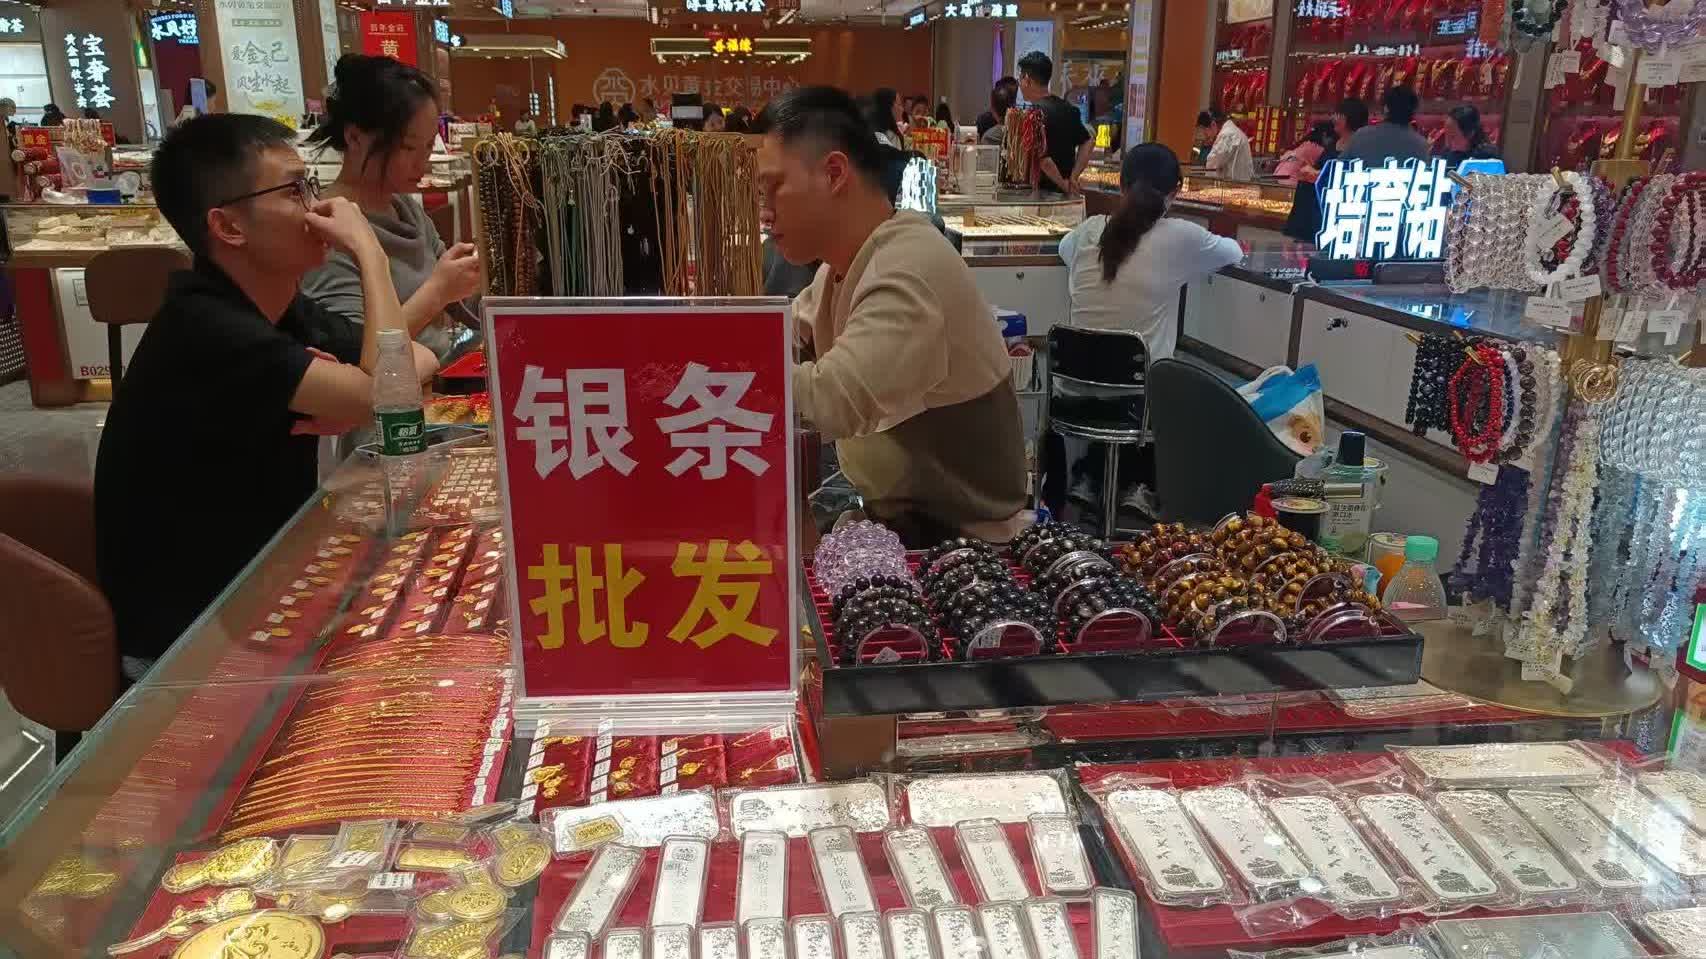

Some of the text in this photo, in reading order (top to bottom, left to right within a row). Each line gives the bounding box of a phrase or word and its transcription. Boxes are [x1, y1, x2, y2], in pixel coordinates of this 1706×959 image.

[1318, 158, 1452, 260] 培育钻
[512, 362, 775, 480] 银条
[527, 539, 780, 650] 批发
